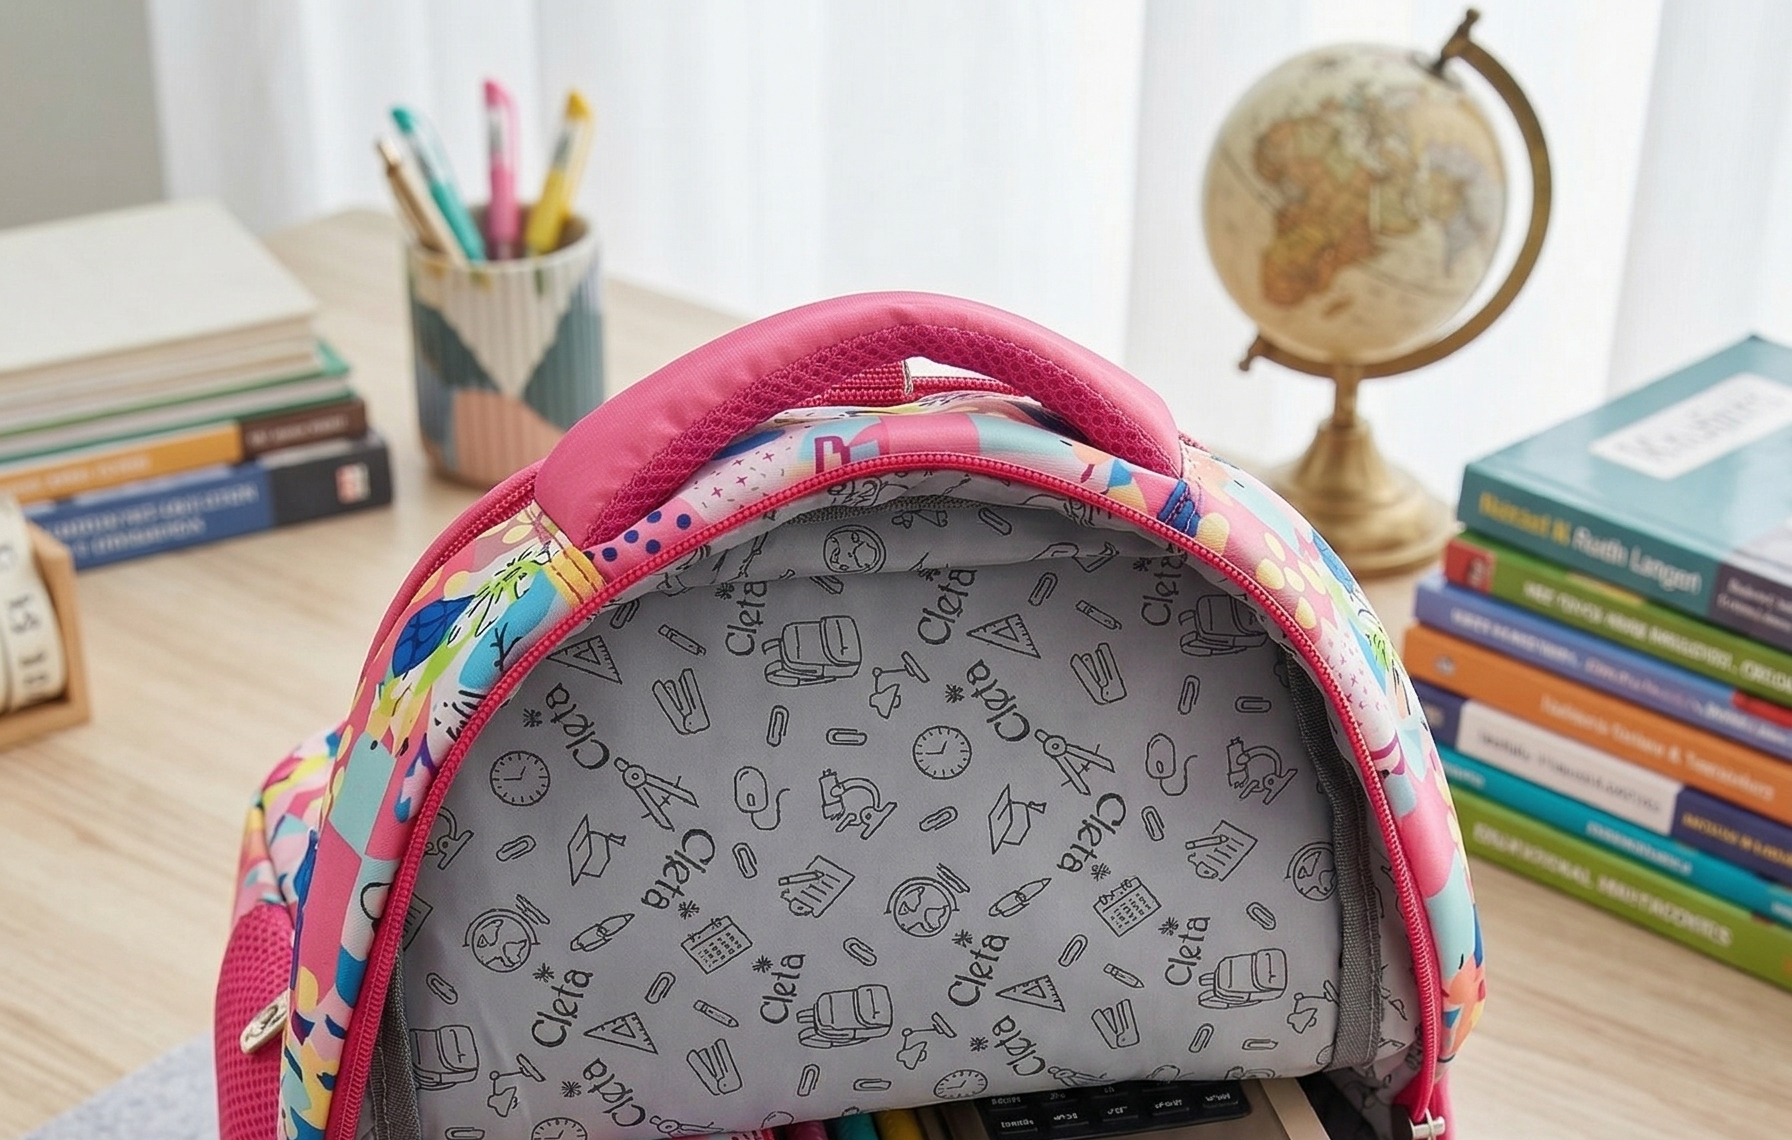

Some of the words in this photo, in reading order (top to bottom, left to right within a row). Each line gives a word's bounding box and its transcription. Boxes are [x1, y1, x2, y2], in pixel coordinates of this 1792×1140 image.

[725, 581, 767, 656] Cleta
[918, 569, 977, 645] Cleta
[546, 682, 610, 770] Cleta
[966, 659, 1031, 742] Cleta
[641, 829, 716, 909] Cleta
[1058, 793, 1127, 872] Cleta
[760, 954, 806, 1024] Cleta
[948, 935, 1009, 1007] Cleta
[1165, 917, 1211, 986] Cleta
[531, 970, 594, 1047] Cleta
[992, 1015, 1046, 1076] Cleta
[583, 1058, 646, 1127] Cleta
